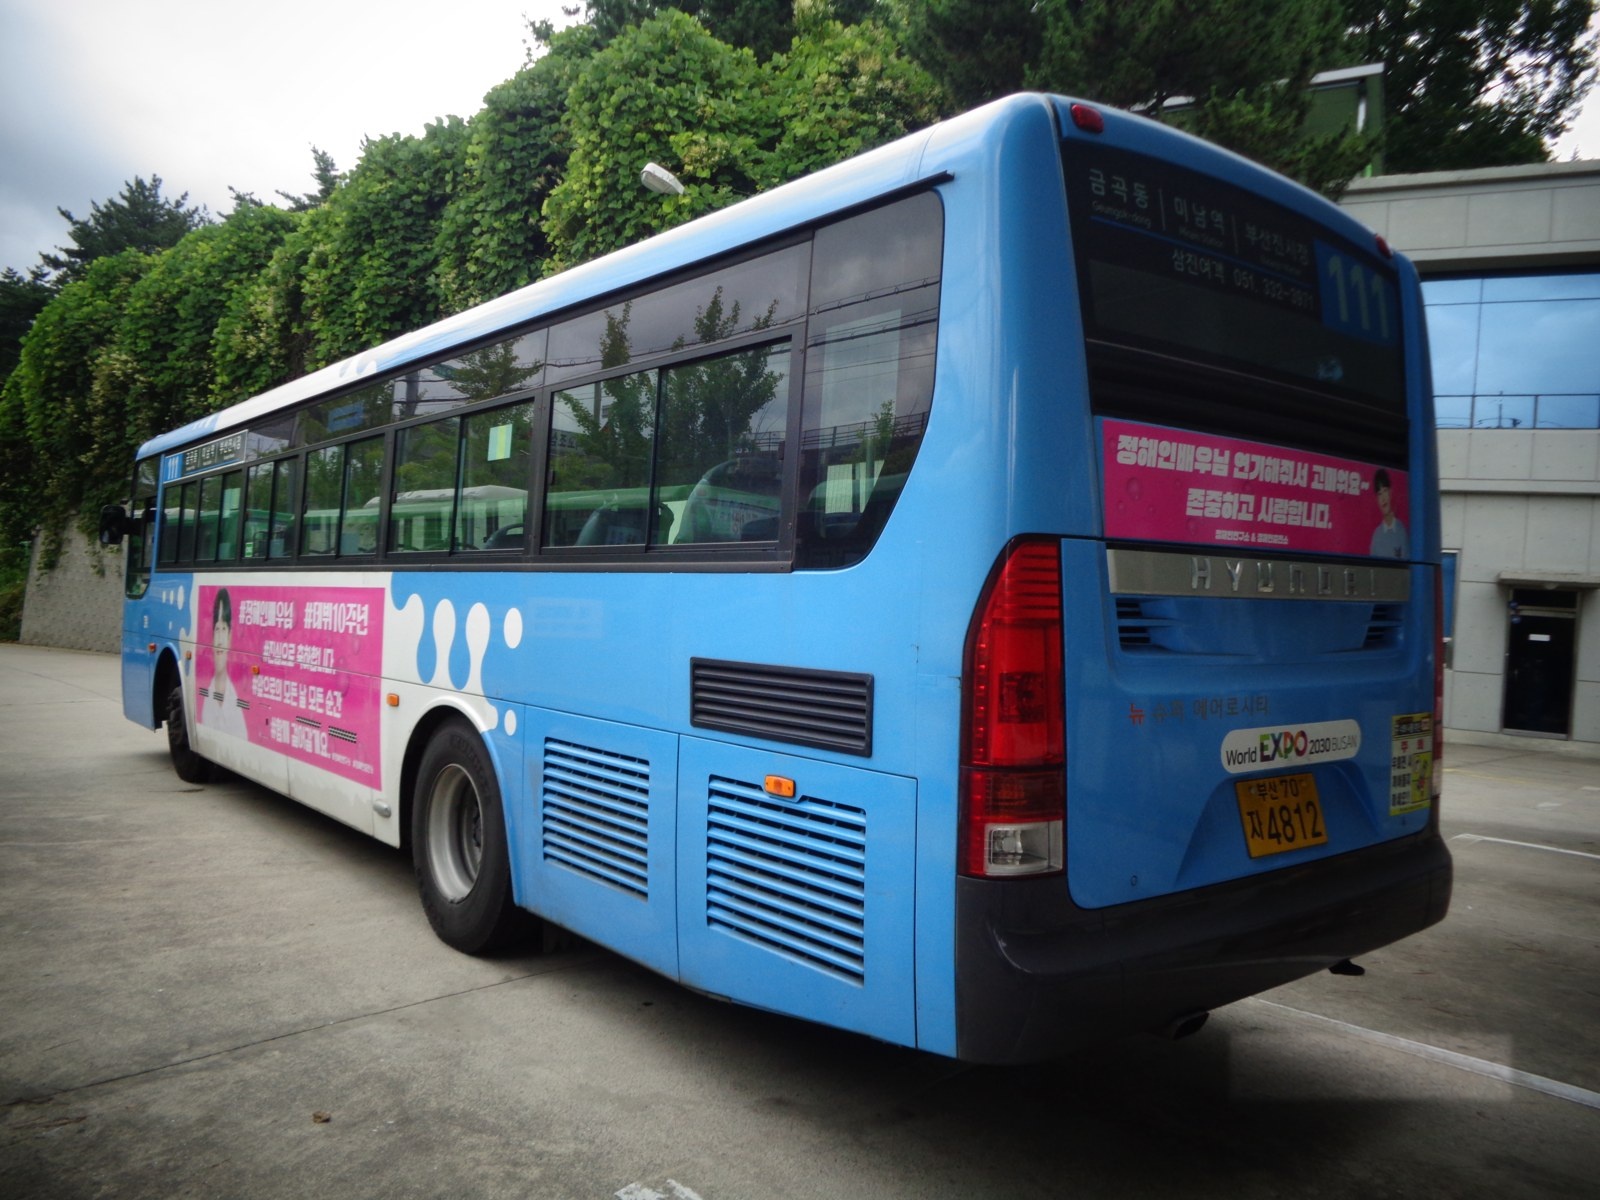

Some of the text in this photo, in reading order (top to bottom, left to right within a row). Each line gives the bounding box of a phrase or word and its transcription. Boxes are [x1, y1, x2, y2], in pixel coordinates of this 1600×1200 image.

[1088, 167, 1149, 210] 금곡동
[1173, 196, 1225, 236] 미남역
[1171, 248, 1225, 285] 삼진여객
[1328, 254, 1389, 340] 111
[1116, 434, 1230, 477] 정해인배우님
[1185, 487, 1333, 530] 존중하고 사랑합니다.
[1190, 556, 1377, 596] HYUNDAI
[303, 601, 369, 636] #데뷔10주년
[283, 680, 298, 707] 모든
[308, 685, 324, 714] 모든
[1129, 702, 1145, 726] 뉴
[1192, 694, 1270, 721] 에어로시티
[1226, 730, 1358, 767] World EXPO 2030 BUSAN
